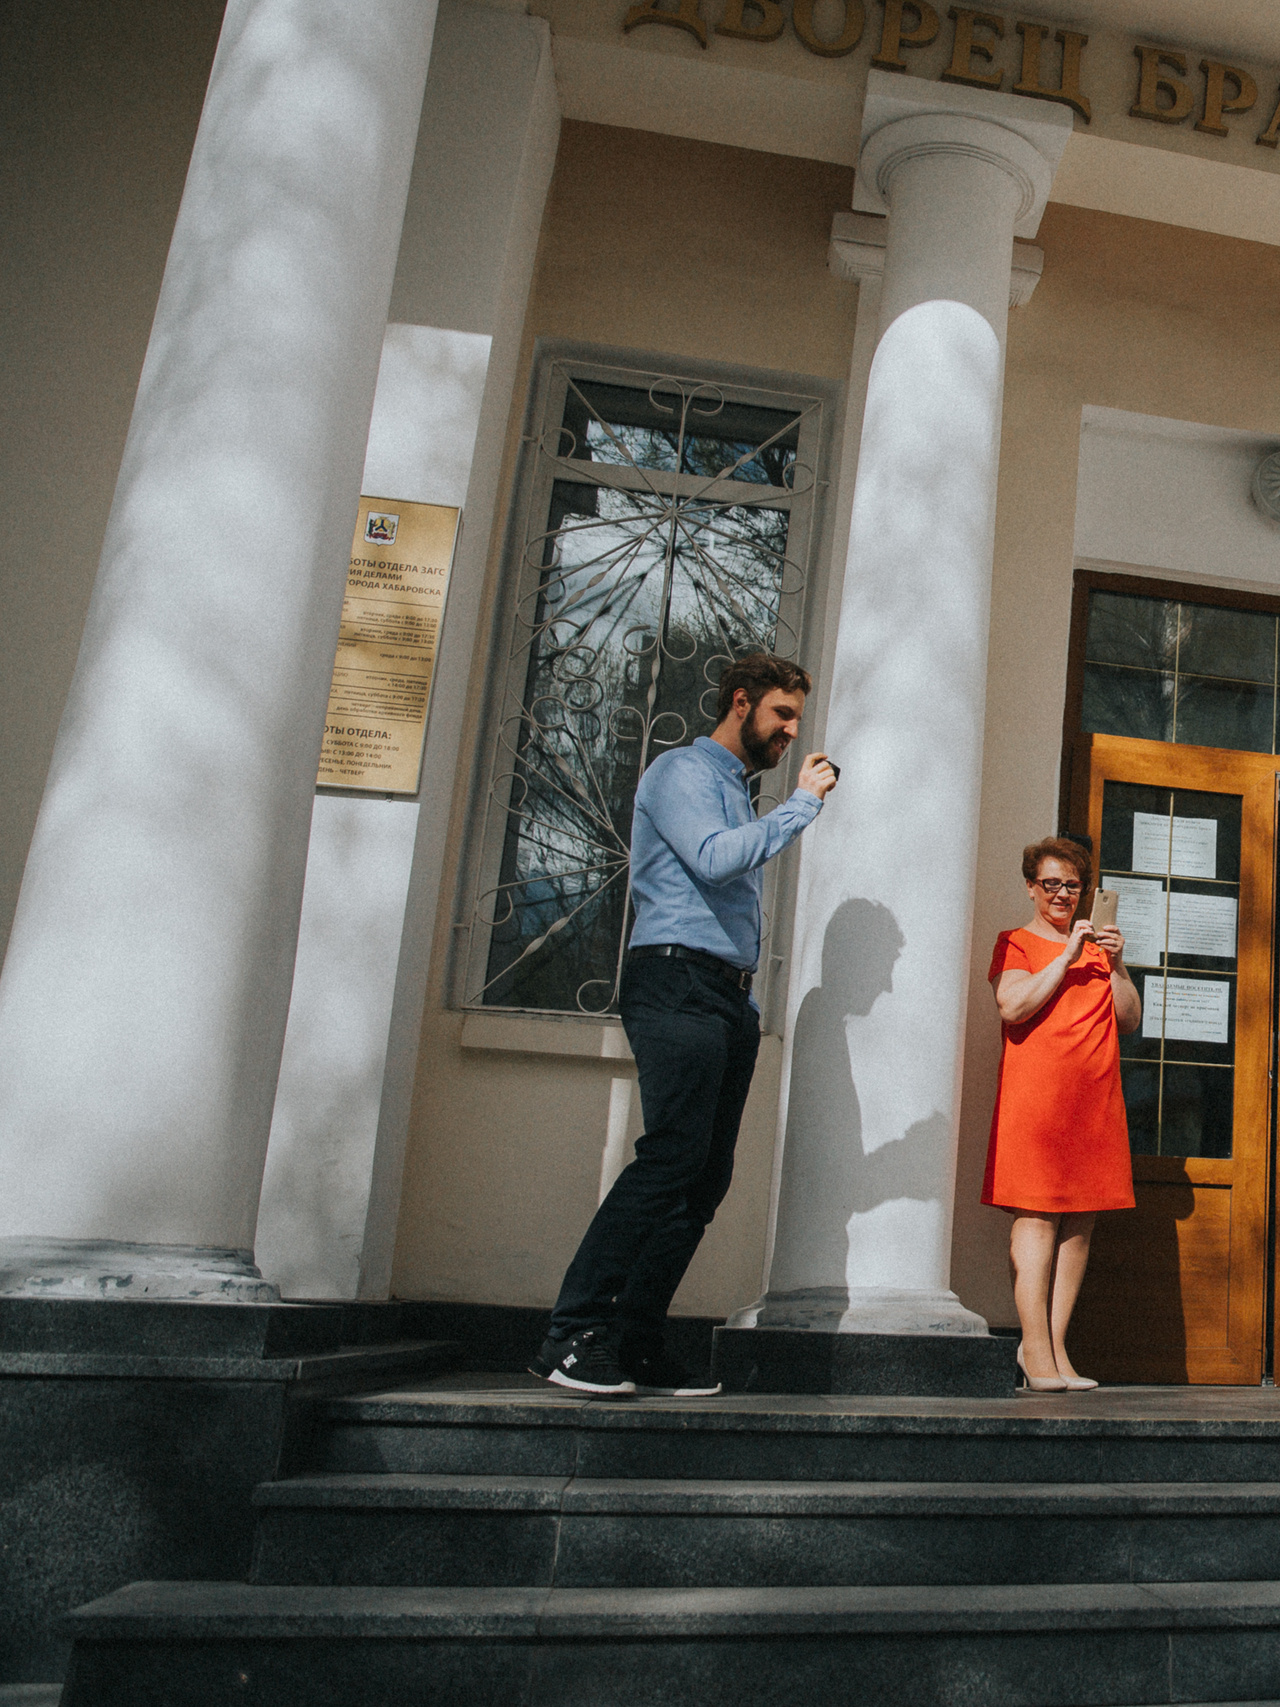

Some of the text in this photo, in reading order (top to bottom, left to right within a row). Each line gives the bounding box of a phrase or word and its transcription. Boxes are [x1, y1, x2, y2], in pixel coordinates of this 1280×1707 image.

[378, 561, 419, 573] ОТДЕЛА
[420, 566, 446, 576] ЗАГС
[363, 570, 402, 581] ДЕЛАМИ
[347, 578, 441, 596] ОРОДА ХАБАРОВСКА
[347, 728, 392, 740] ОТДЕЛА:
[326, 739, 354, 747] СУББОТА
